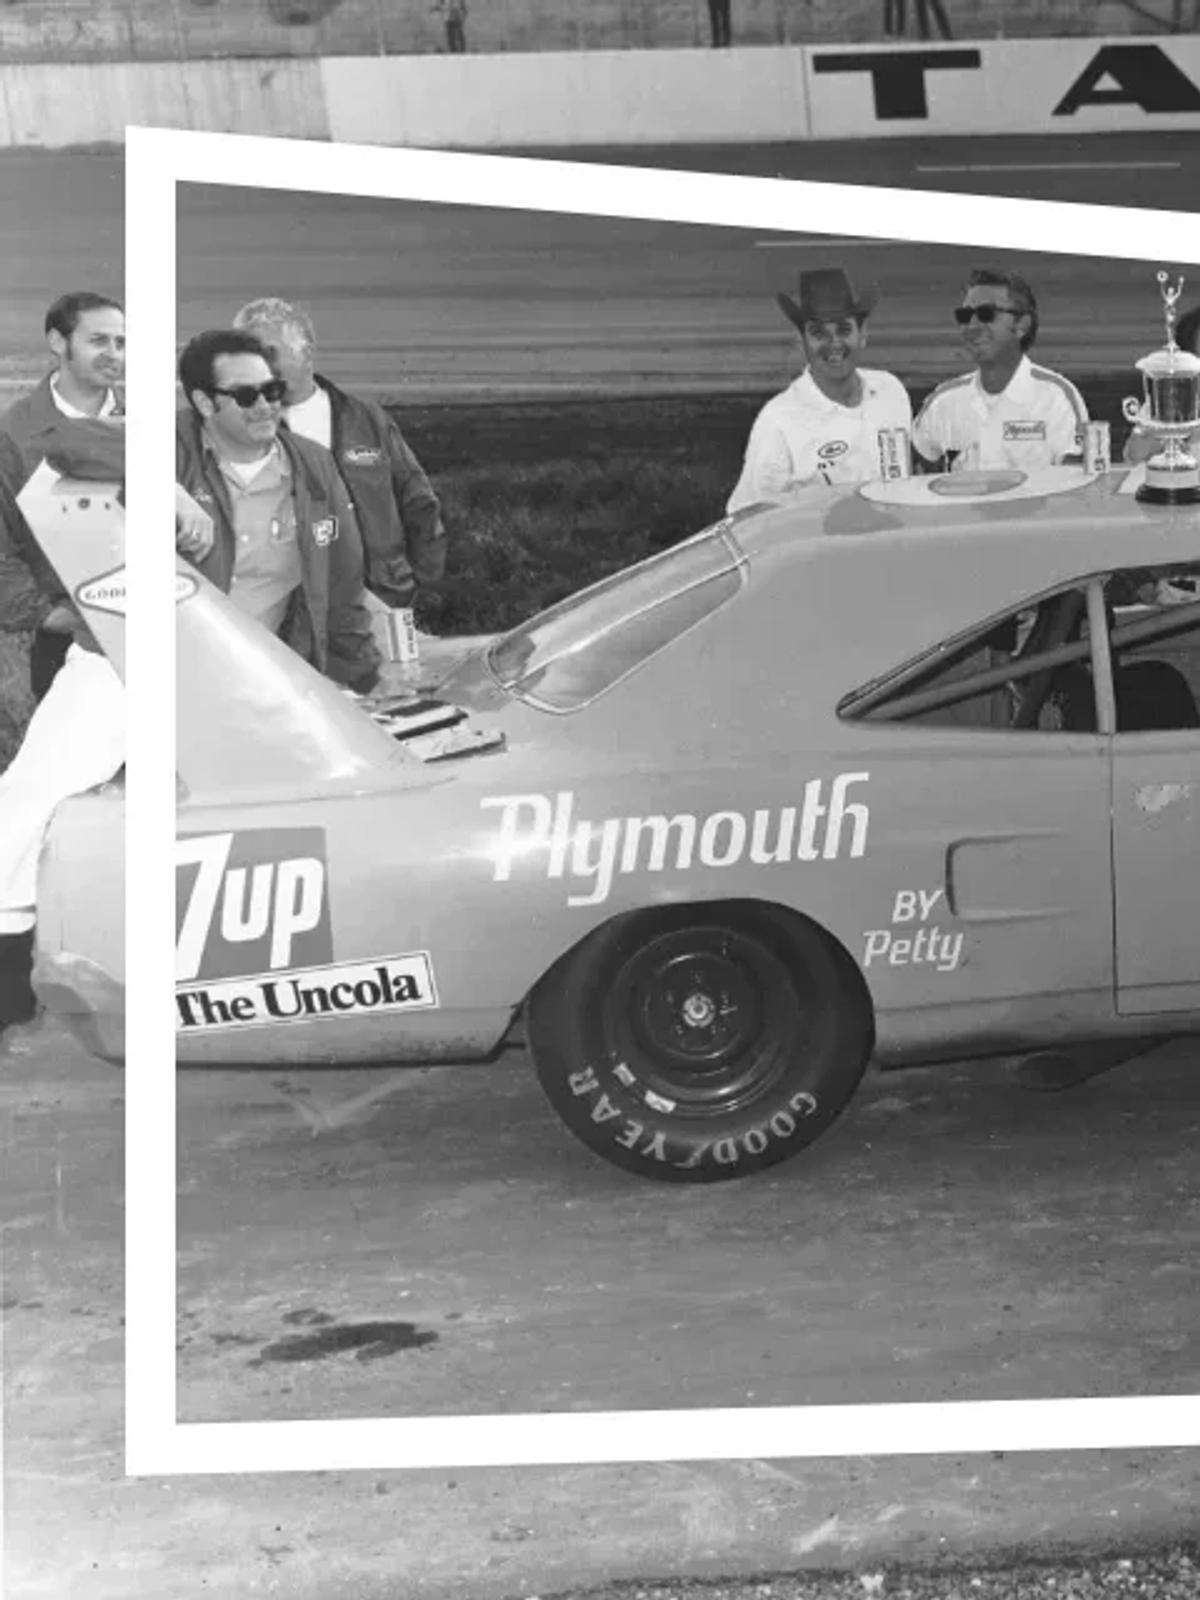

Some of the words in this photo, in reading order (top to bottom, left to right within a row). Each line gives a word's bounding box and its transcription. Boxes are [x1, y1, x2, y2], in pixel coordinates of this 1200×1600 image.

[480, 772, 869, 907] Plymouth
[892, 889, 944, 923] BY
[863, 926, 964, 972] Petty
[175, 989, 256, 1027] The
[260, 966, 422, 1018] Uncola
[567, 1066, 818, 1169] GOODYEAR
